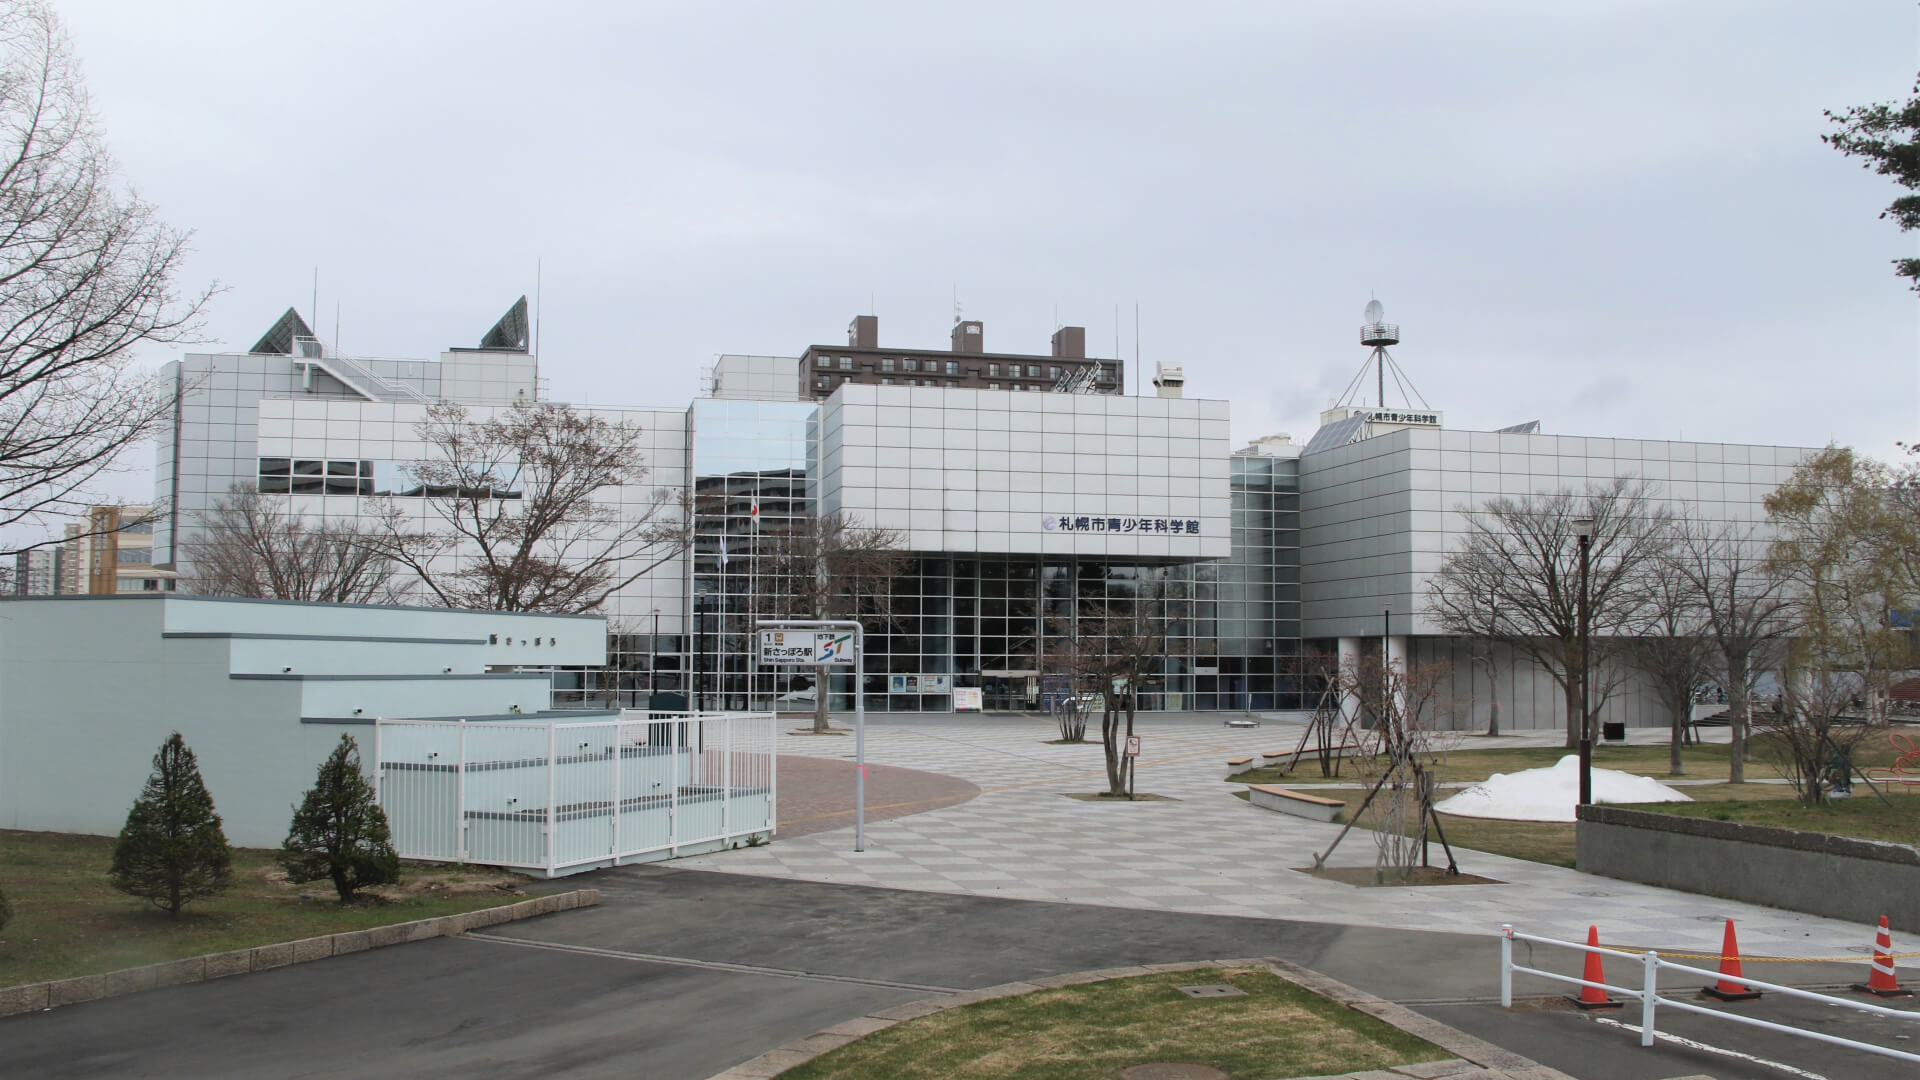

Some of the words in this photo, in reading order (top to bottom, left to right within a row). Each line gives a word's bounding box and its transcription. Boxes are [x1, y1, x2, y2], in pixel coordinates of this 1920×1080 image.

[1059, 516, 1199, 534] 札幌市青少年科学館
[765, 633, 770, 642] 1
[763, 647, 813, 656] 新さっぽろ駅
